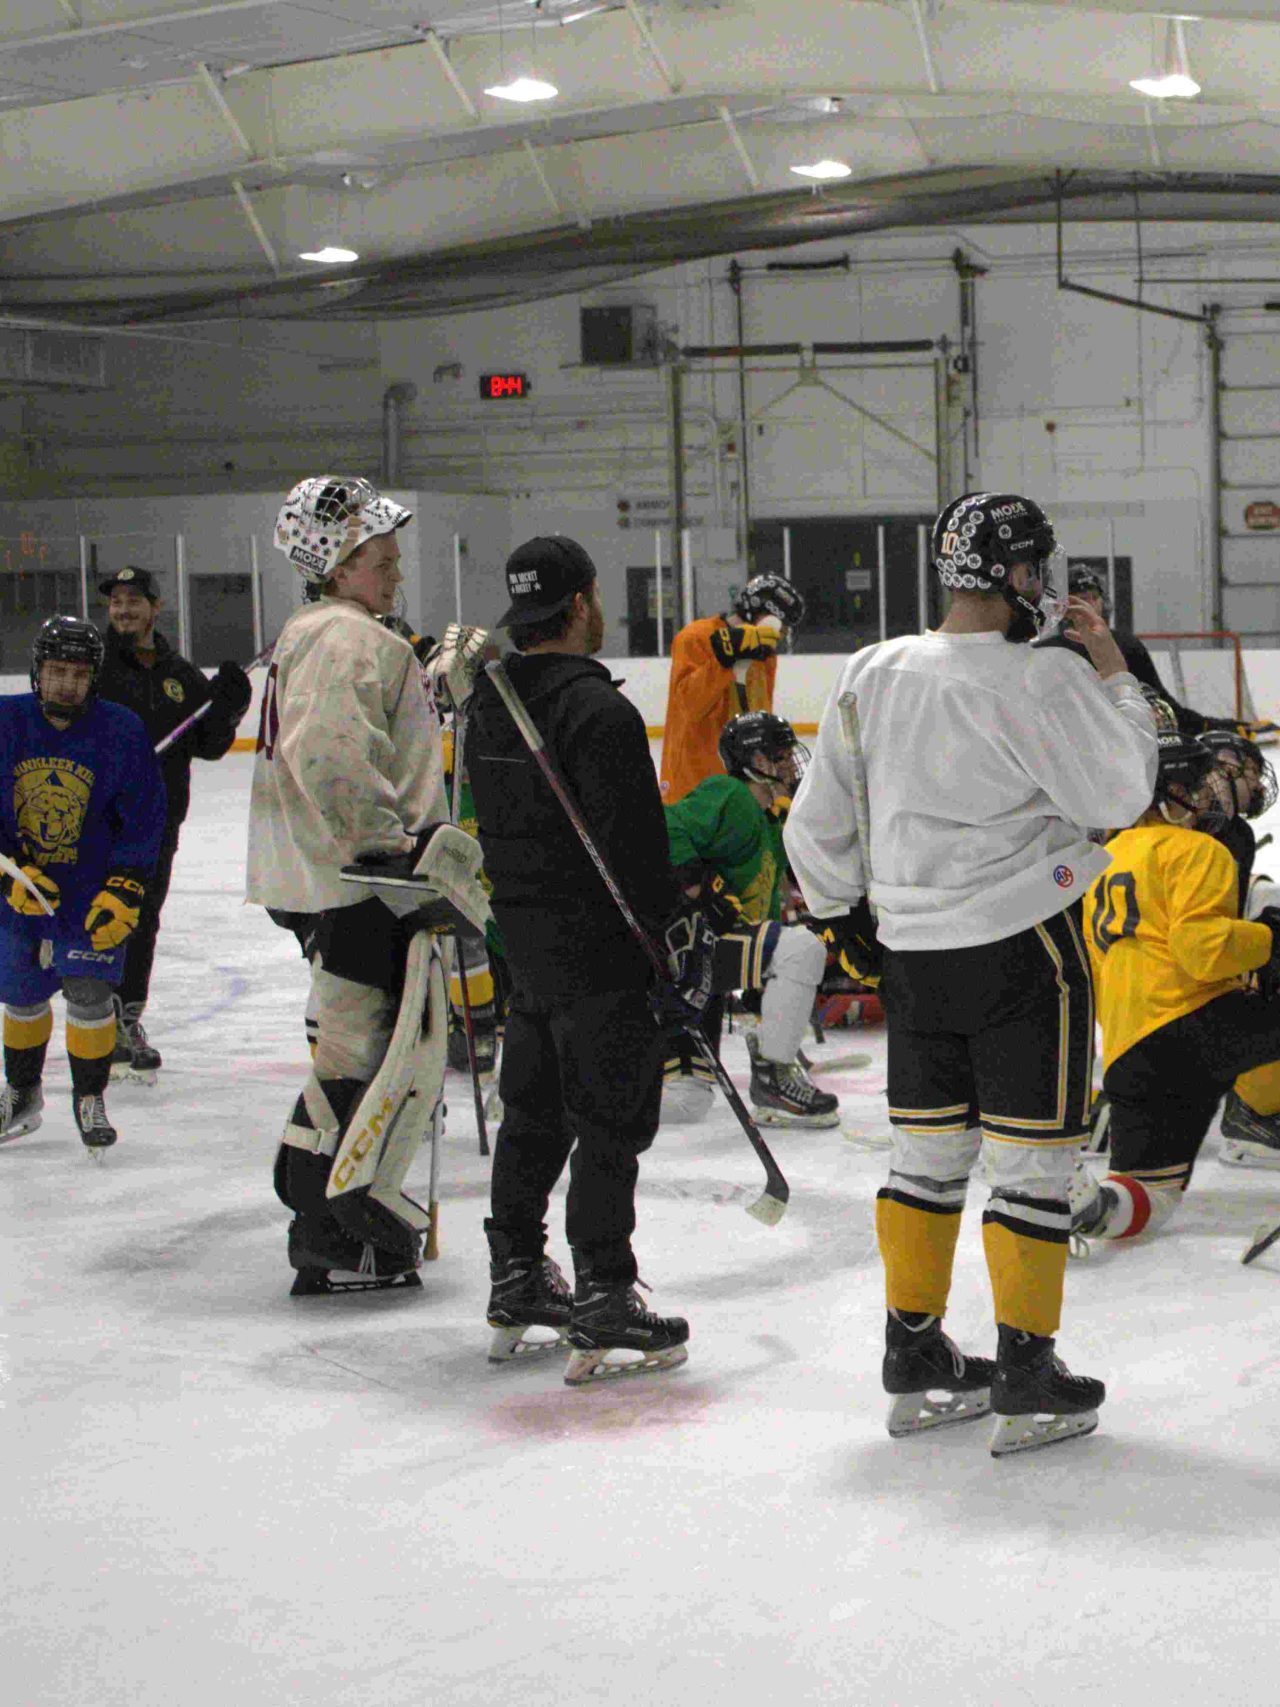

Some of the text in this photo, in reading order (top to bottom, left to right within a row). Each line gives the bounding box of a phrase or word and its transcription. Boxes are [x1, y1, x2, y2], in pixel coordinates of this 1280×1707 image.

[942, 532, 958, 555] 10
[1010, 540, 1034, 551] CCM
[719, 628, 734, 656] CC
[67, 950, 114, 964] CCM
[334, 1097, 394, 1190] CCM
